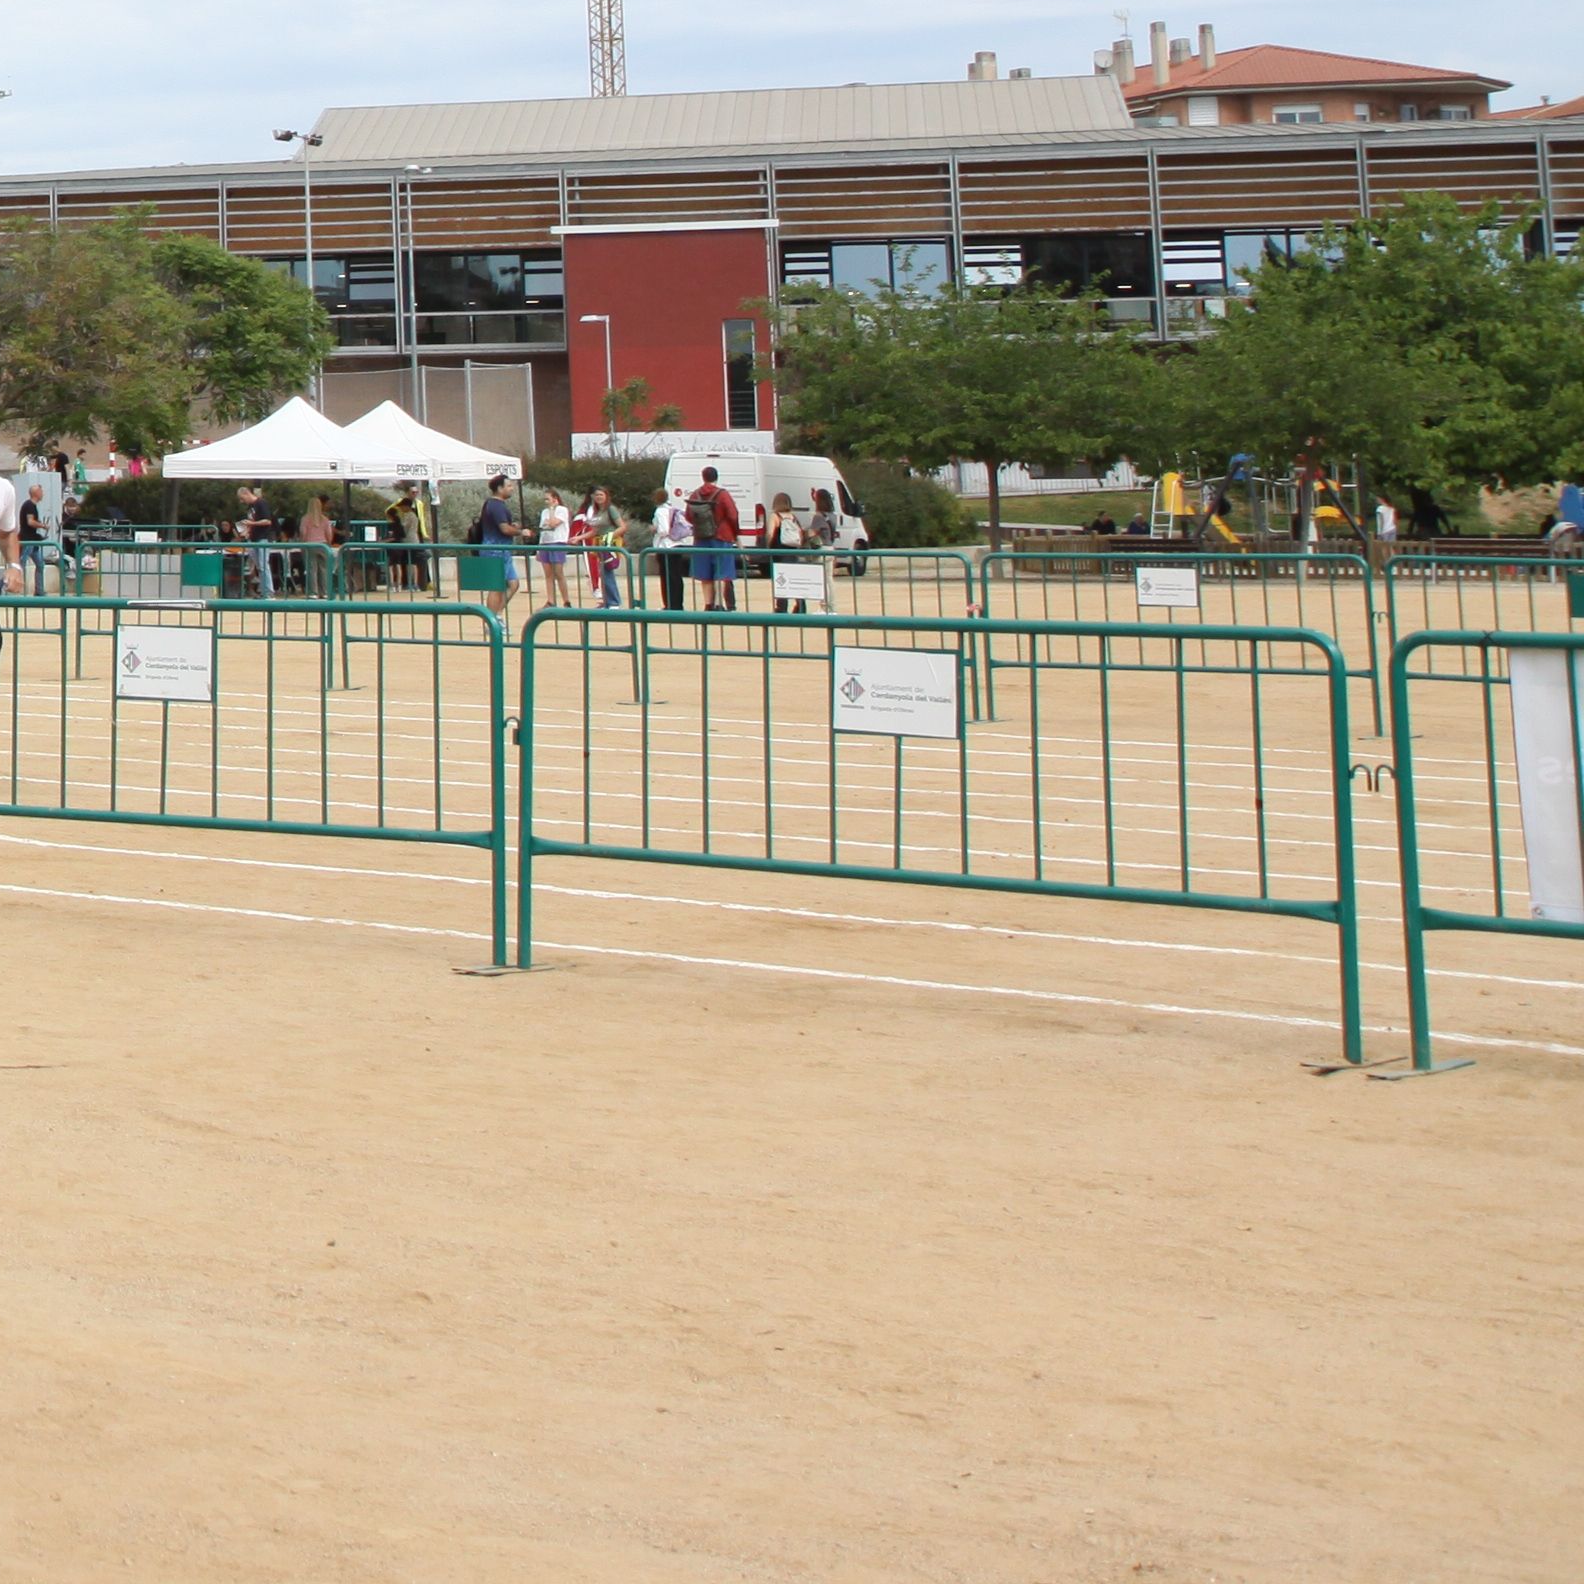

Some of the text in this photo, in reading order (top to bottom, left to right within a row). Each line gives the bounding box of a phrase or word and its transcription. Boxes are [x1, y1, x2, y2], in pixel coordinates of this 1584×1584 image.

[396, 463, 428, 476] ESPORTS
[485, 463, 519, 476] ESPORTS
[870, 691, 913, 701] Cerdanyola
